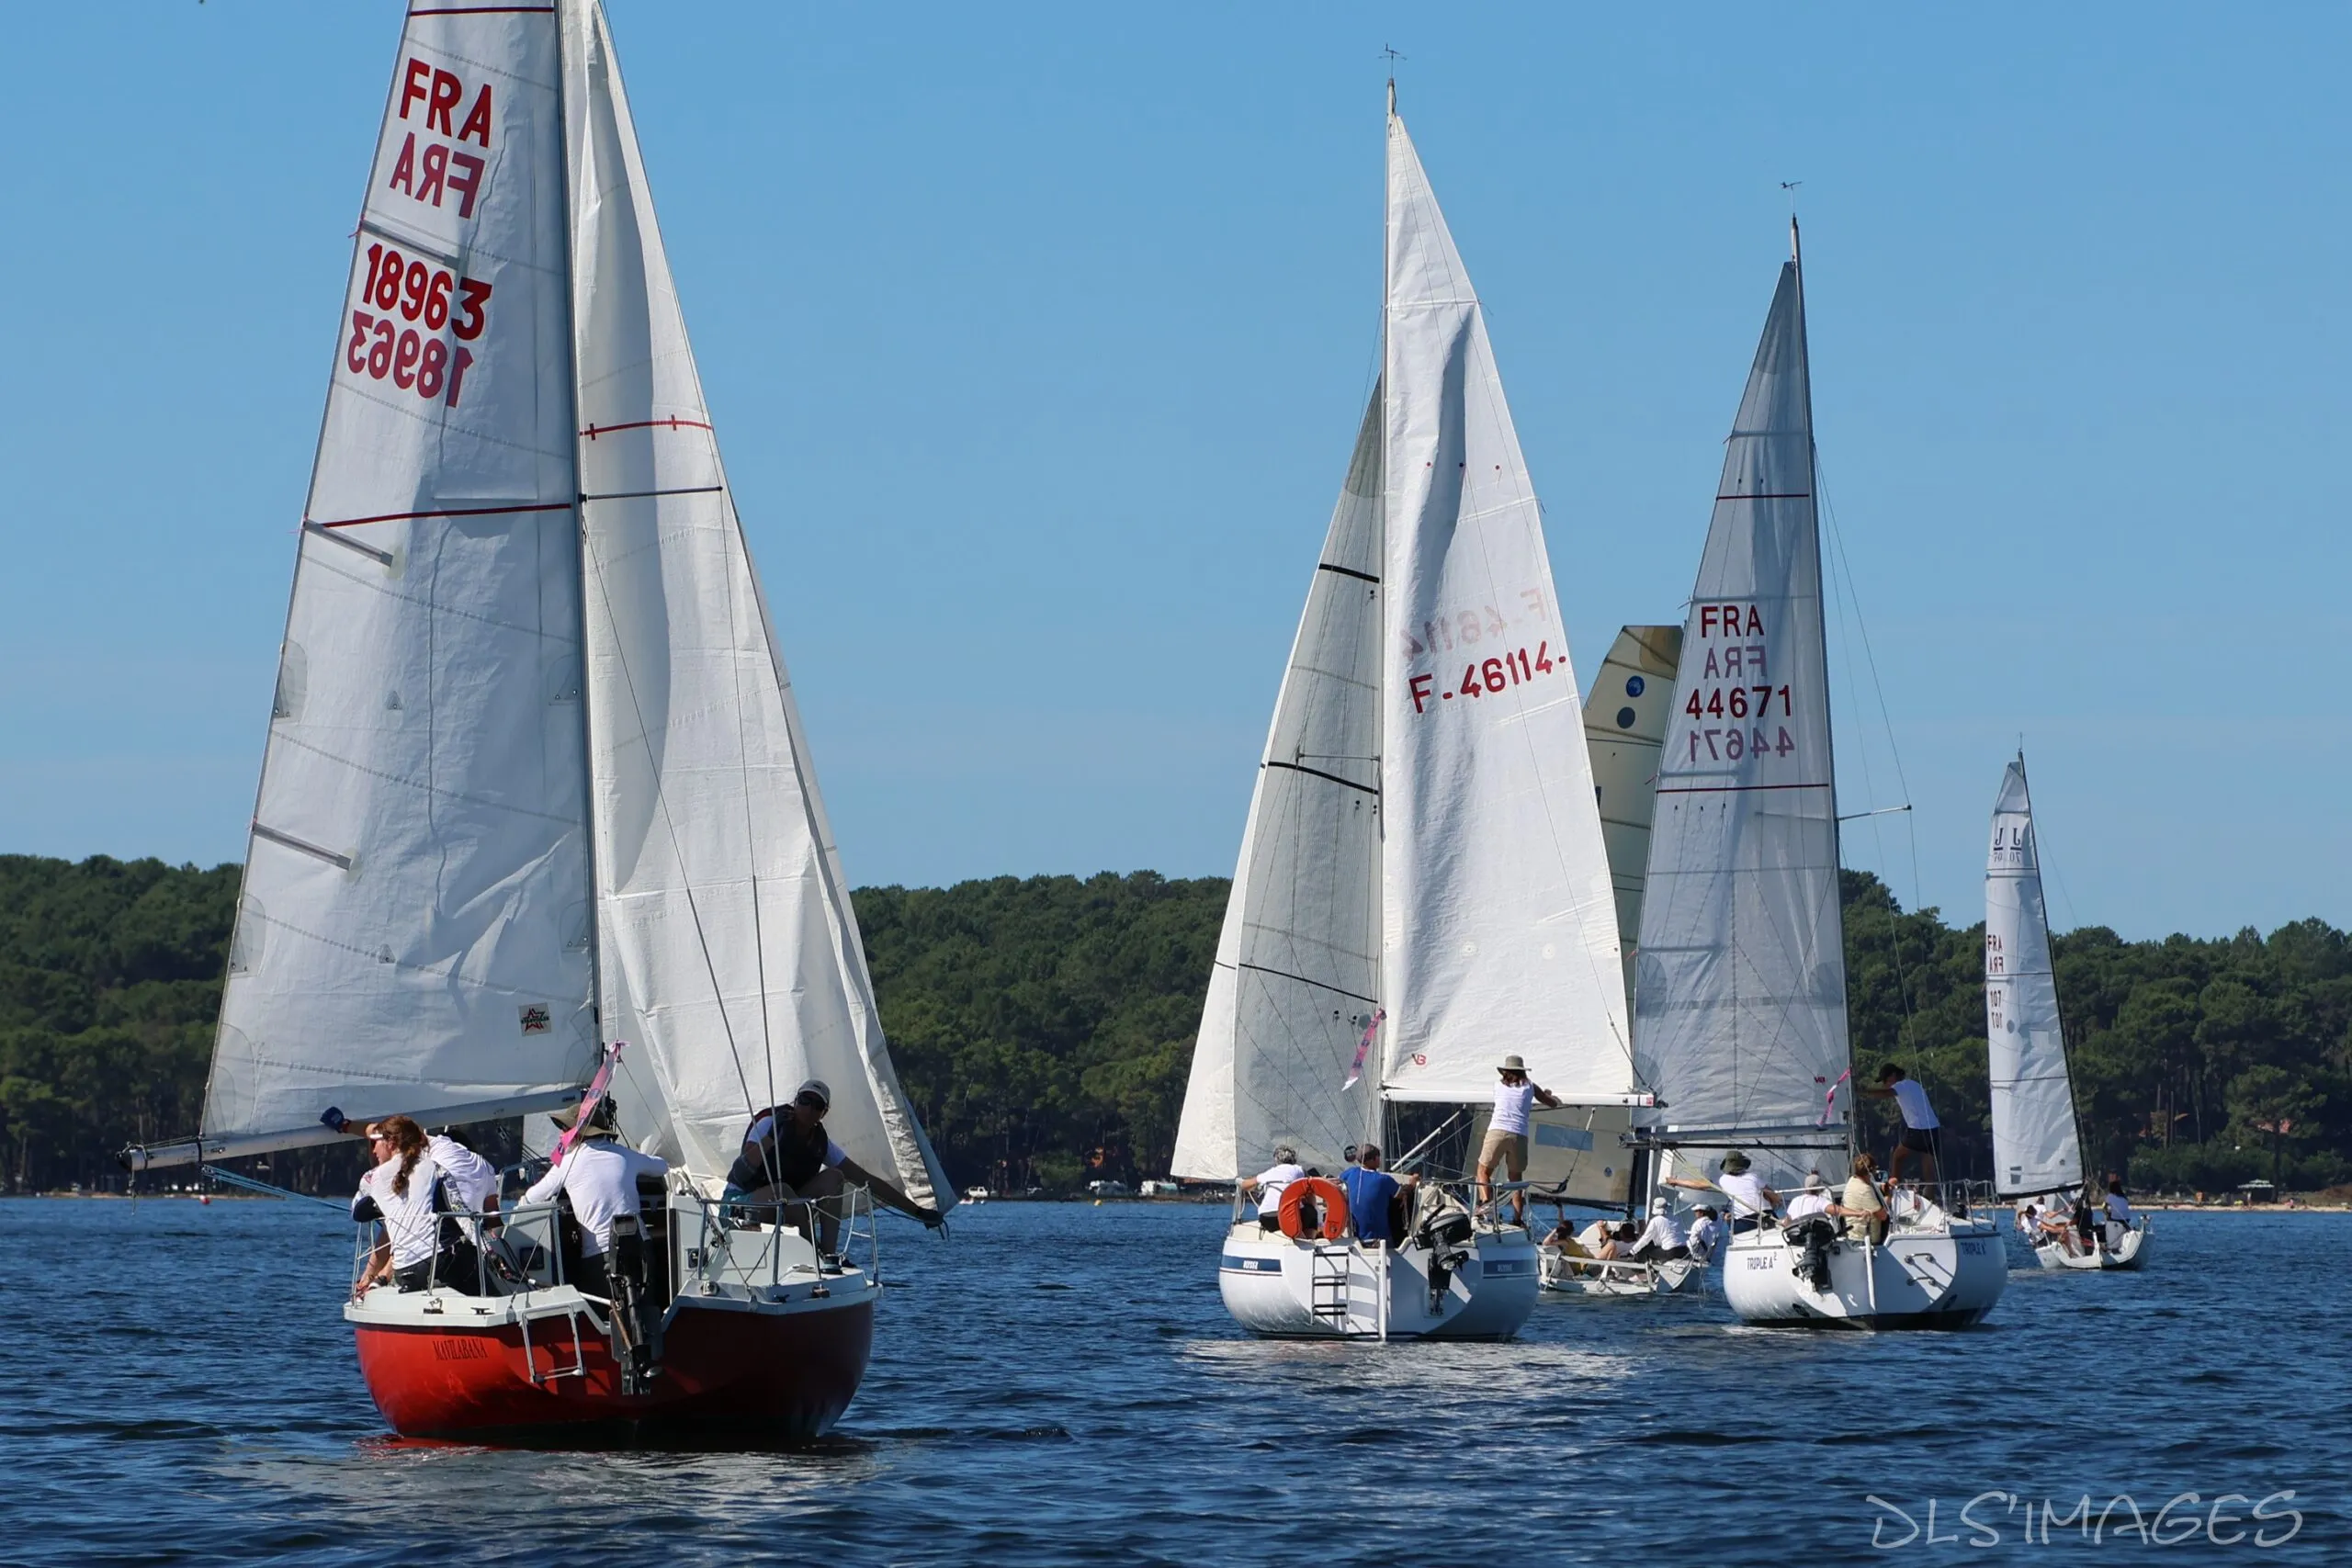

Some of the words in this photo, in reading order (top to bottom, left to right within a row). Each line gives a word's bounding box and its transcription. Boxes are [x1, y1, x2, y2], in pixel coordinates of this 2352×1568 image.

[399, 57, 492, 148] FRA
[362, 243, 493, 342] 18963
[1701, 604, 1765, 638] FRA
[1686, 684, 1792, 721] 44671
[1987, 934, 2003, 952] FRA
[1747, 1257, 1768, 1270] TRIPLE
